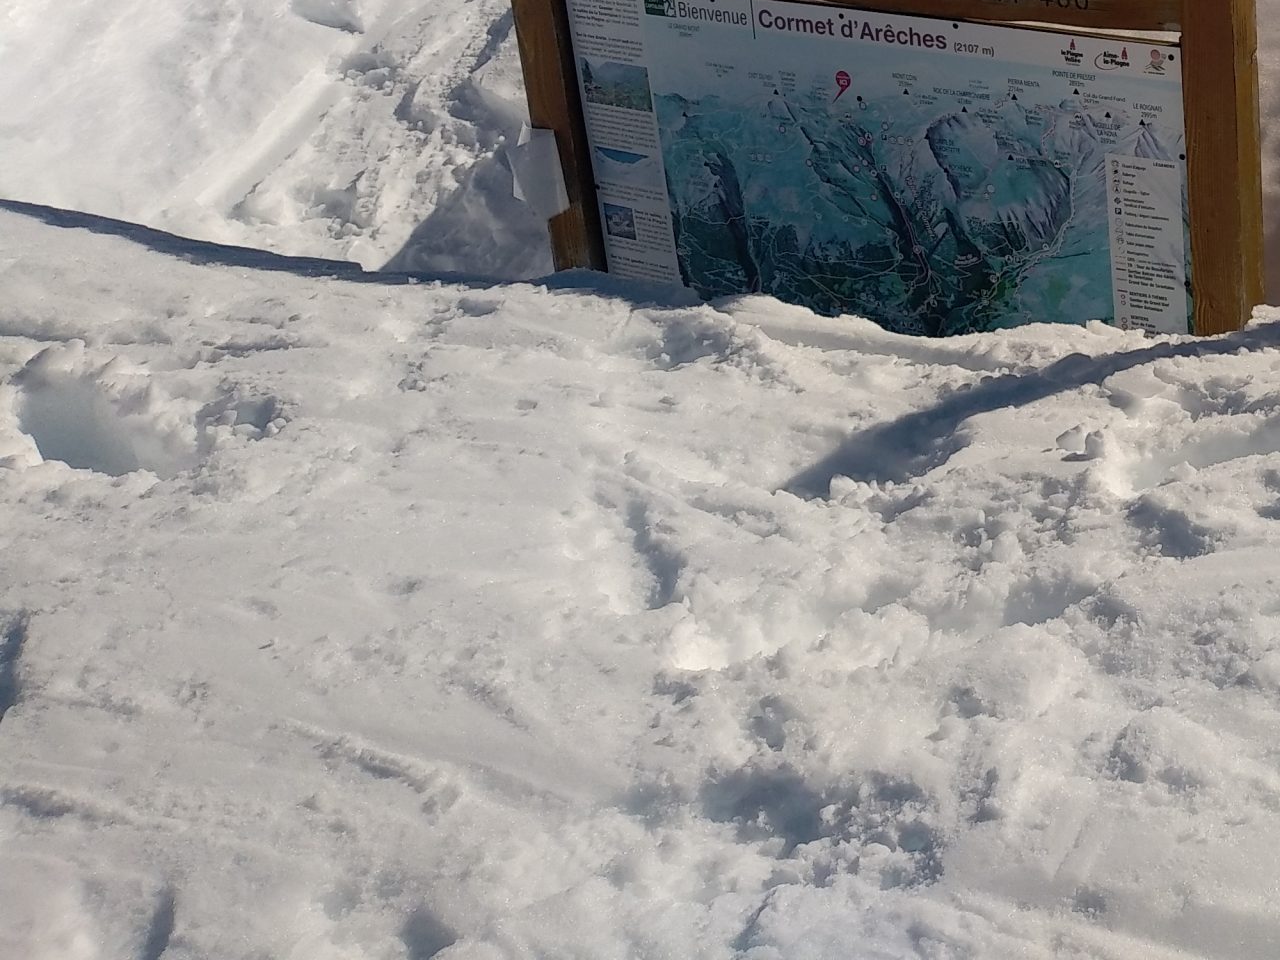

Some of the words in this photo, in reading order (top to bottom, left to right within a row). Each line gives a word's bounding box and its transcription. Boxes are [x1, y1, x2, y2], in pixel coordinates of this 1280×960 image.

[677, 0, 748, 26] Bienvenue
[758, 8, 835, 37] Cormet
[840, 21, 947, 50] d'Arêches
[953, 41, 978, 54] (2107
[981, 46, 995, 58] m)
